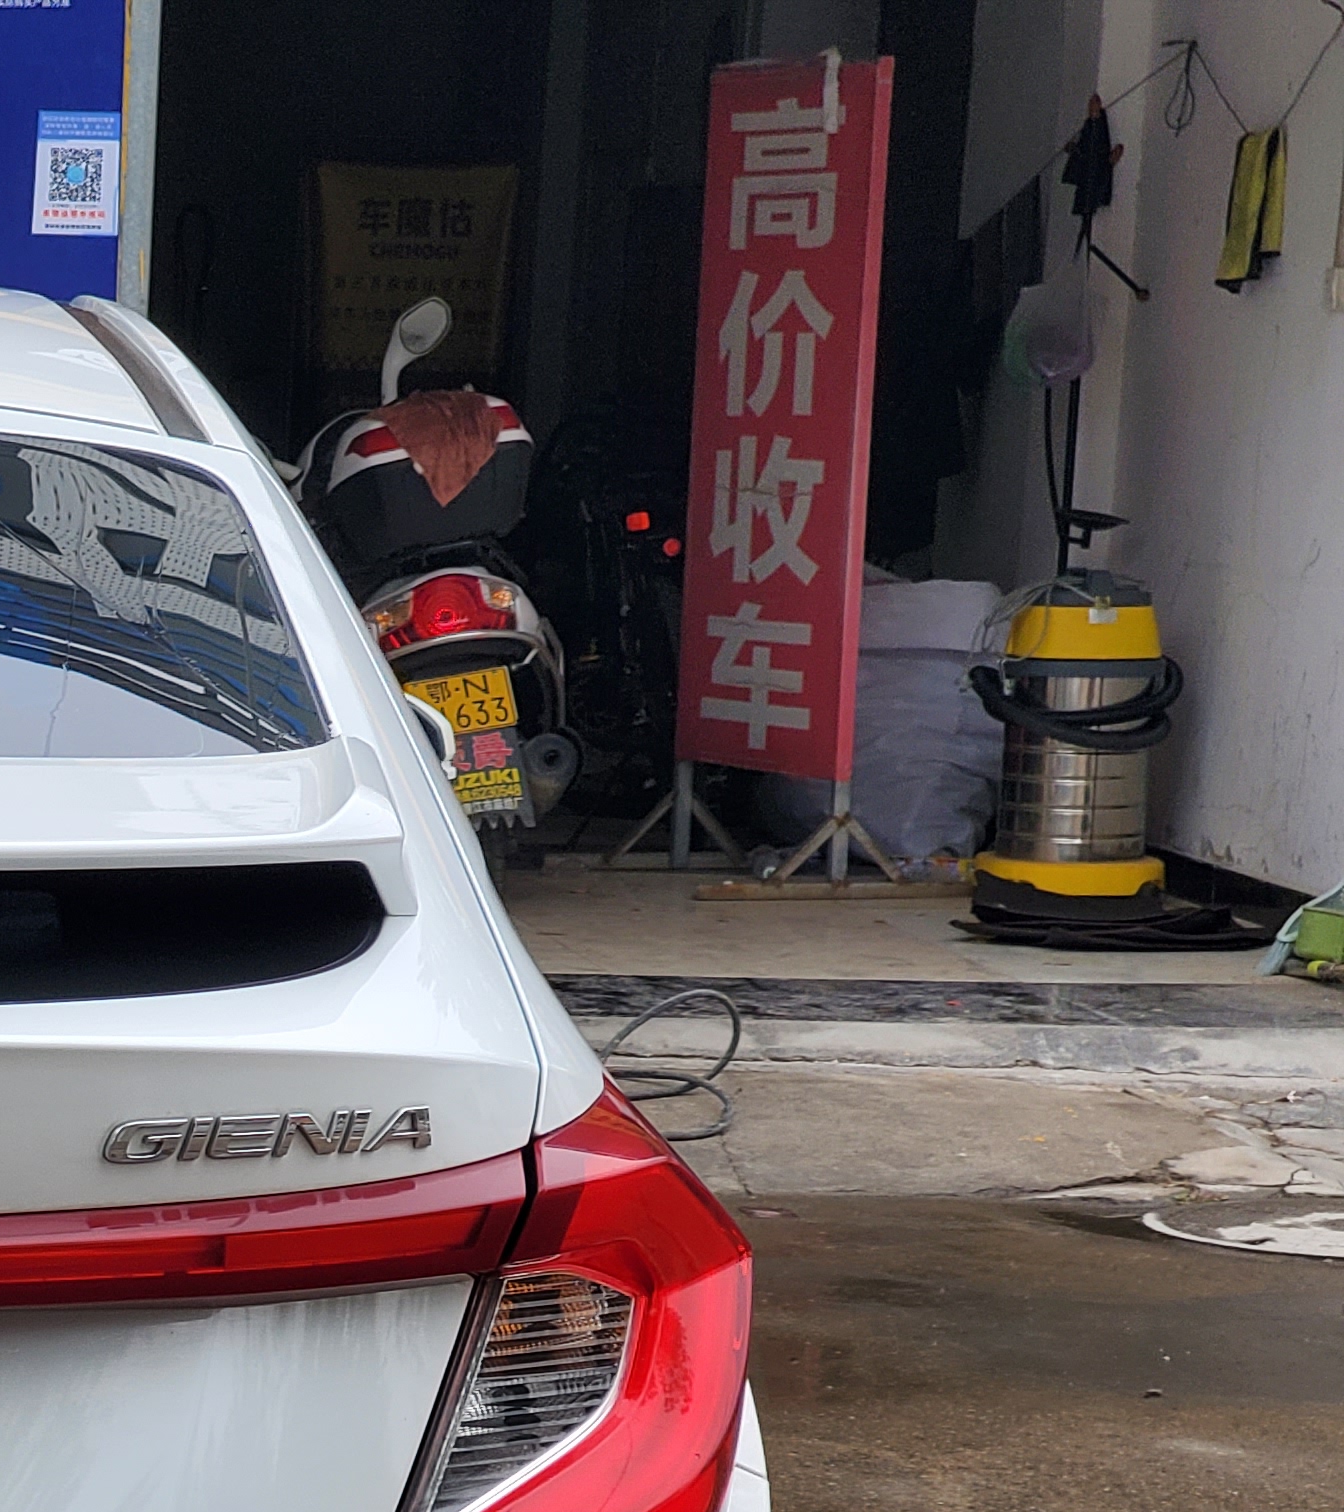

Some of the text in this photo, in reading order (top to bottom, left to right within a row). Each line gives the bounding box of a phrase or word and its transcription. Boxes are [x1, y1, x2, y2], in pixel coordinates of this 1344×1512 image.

[700, 97, 846, 751] 高价收车
[440, 696, 509, 728] 633
[102, 1104, 433, 1165] GIENIA
